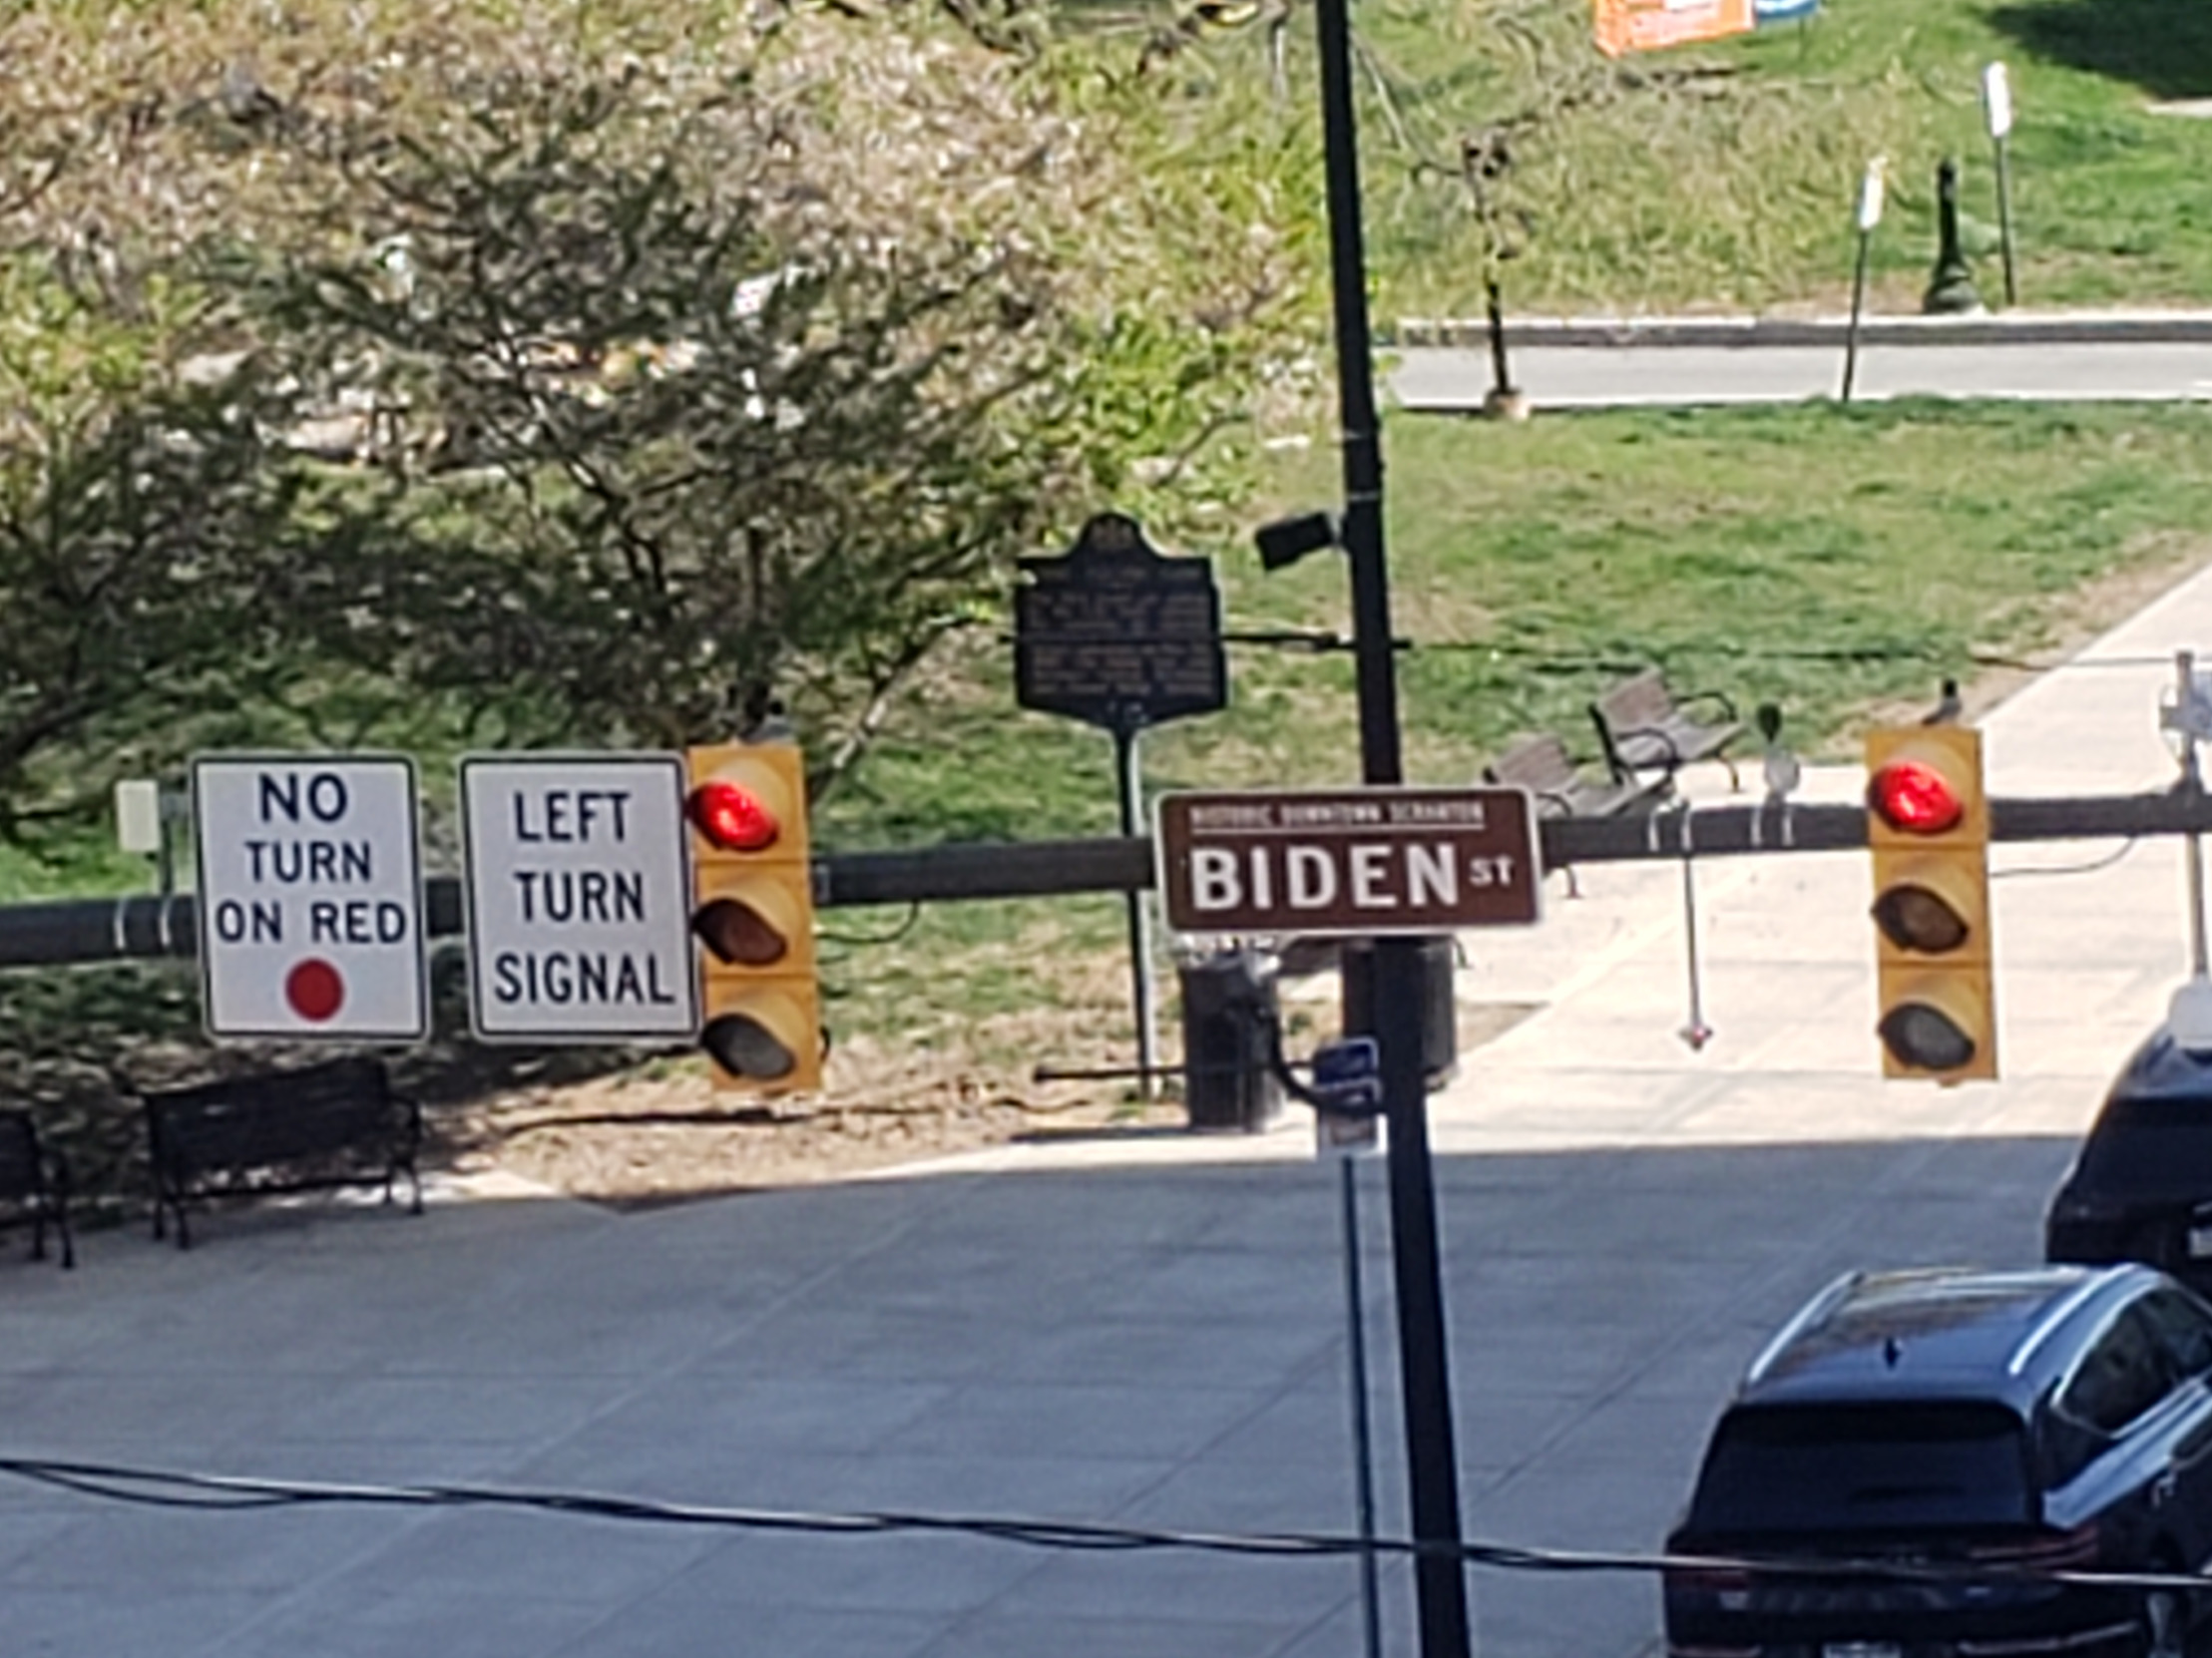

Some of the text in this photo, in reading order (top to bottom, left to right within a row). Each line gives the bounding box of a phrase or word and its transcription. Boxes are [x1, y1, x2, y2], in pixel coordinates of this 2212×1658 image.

[260, 774, 348, 821] NO
[515, 792, 631, 841] LEFT
[245, 842, 372, 882] TURN
[1190, 844, 1515, 910] BIDEN ST
[515, 872, 645, 922] TURN
[217, 902, 406, 944] ON RED
[495, 955, 674, 1004] SIGNAL
